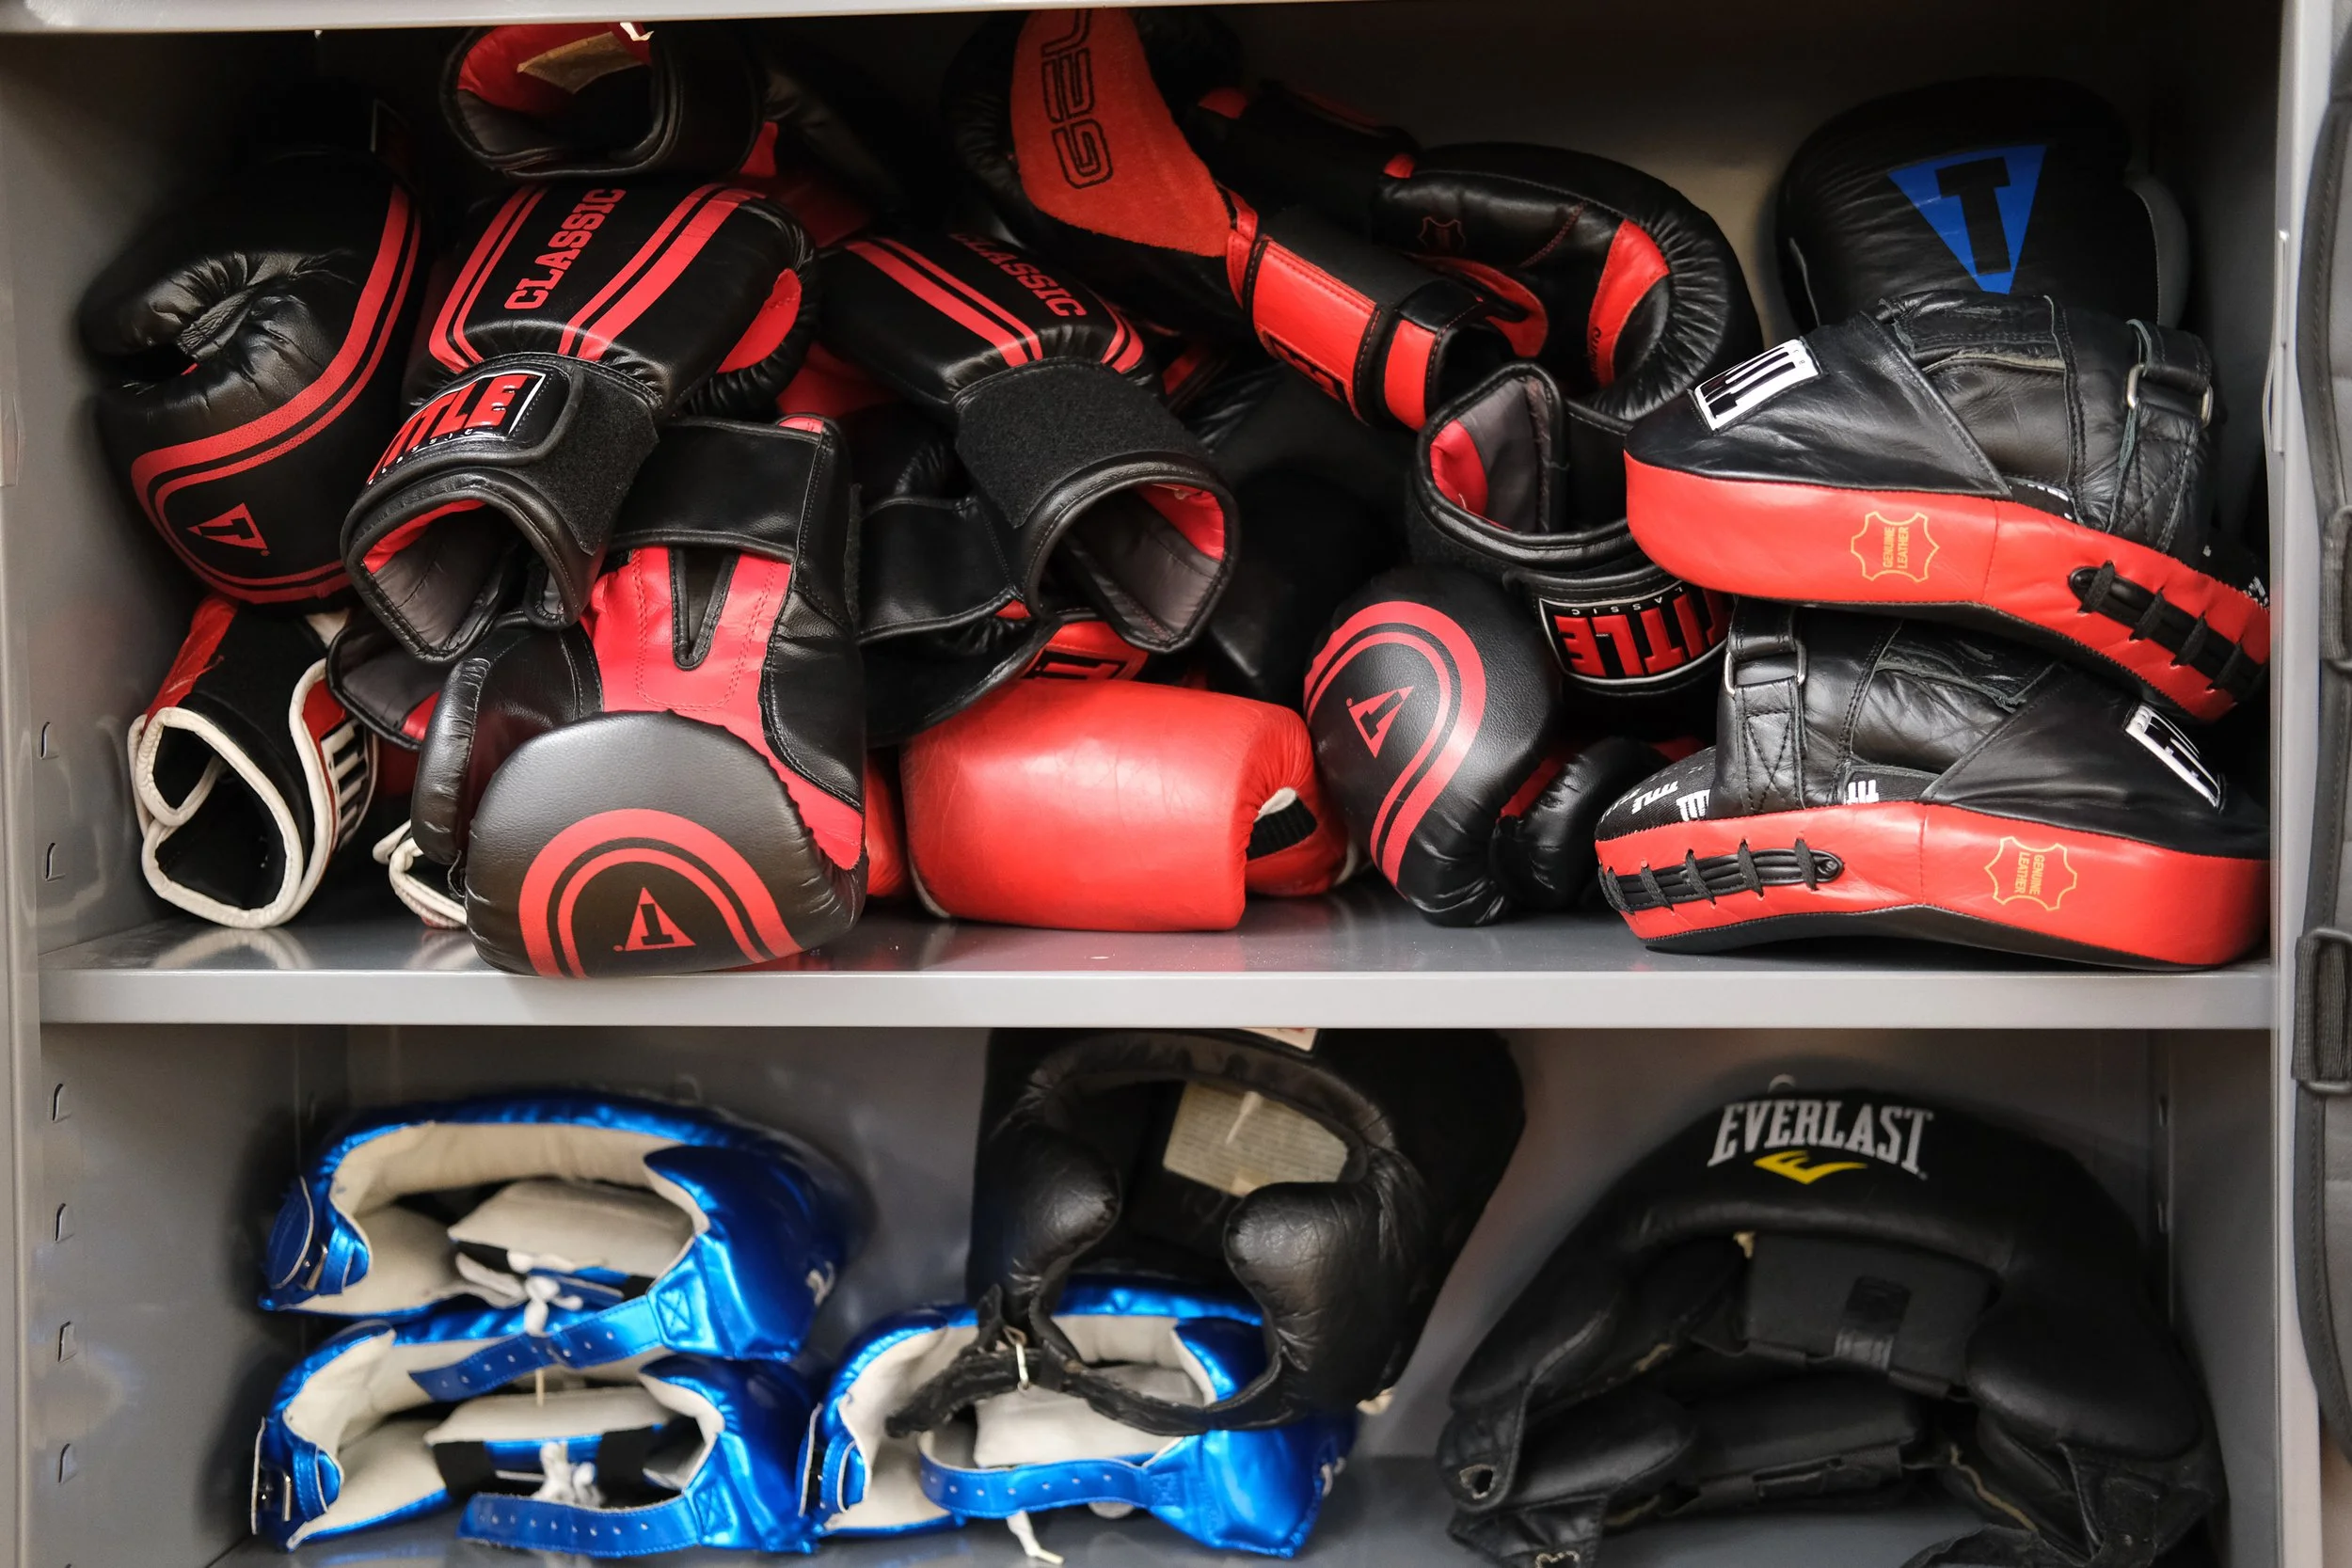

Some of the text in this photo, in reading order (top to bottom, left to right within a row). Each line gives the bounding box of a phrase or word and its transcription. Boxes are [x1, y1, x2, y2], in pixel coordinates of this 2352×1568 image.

[504, 189, 627, 309] CLASSIC
[1883, 527, 1895, 568] GENUINE
[1897, 526, 1909, 569] LEATHER
[1571, 587, 1684, 616] LASSIC
[2014, 851, 2030, 895] LEATHER
[2028, 854, 2045, 895] GENUINE
[1707, 1100, 1934, 1175] EVERLAST
